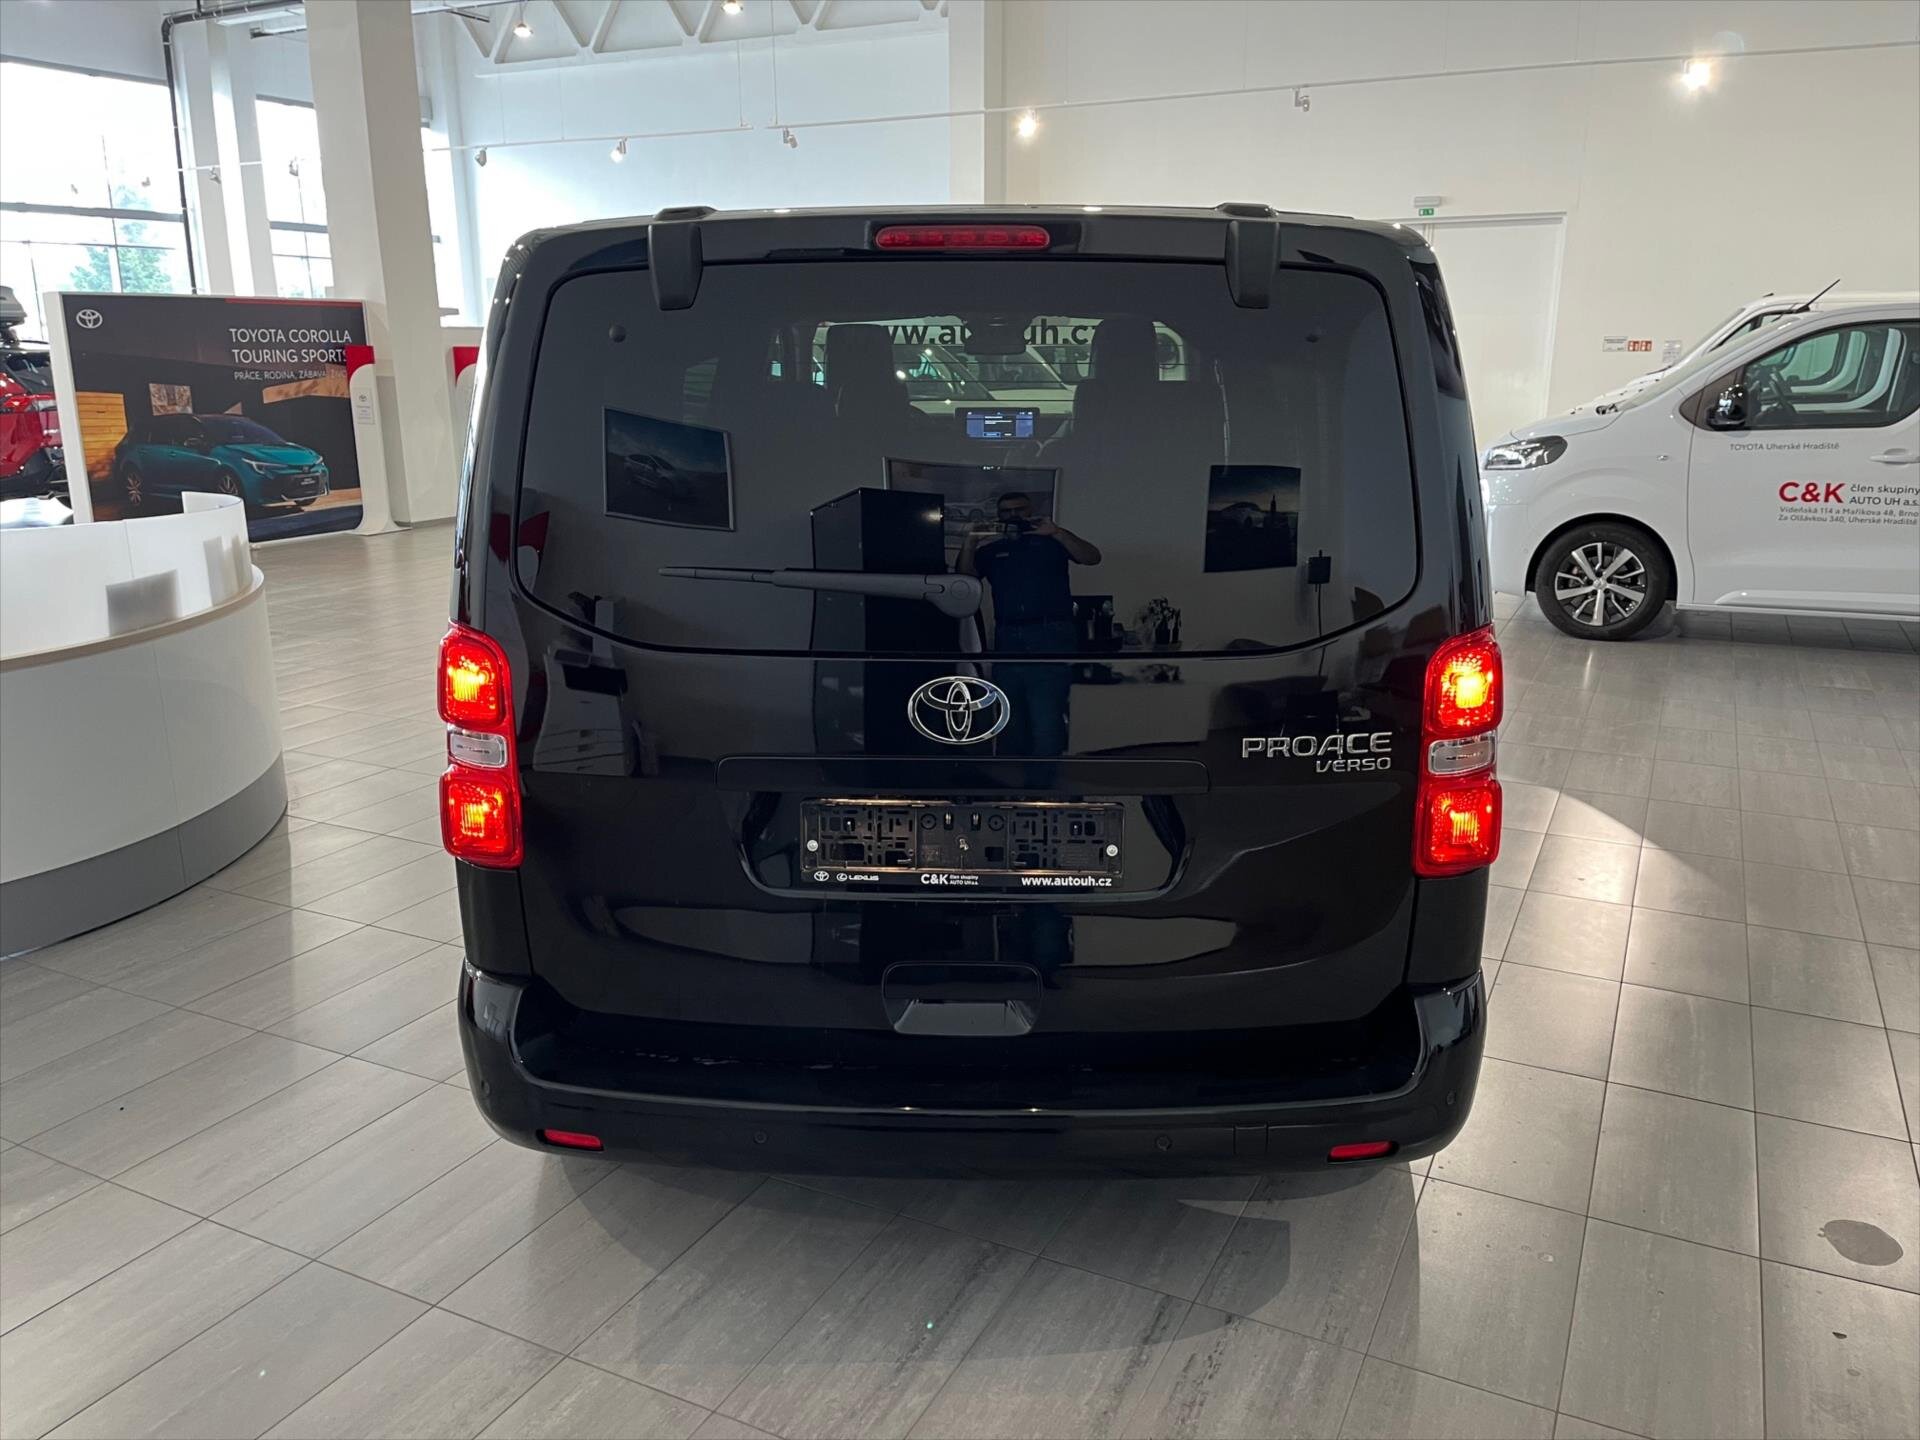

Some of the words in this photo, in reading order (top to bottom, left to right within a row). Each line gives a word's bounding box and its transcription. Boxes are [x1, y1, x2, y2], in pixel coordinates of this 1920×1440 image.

[229, 328, 286, 343] TOYOTA
[288, 329, 352, 343] COROLLA
[232, 349, 298, 363] TOURING
[264, 371, 297, 380] RODINA,
[1730, 443, 1765, 451] TOYOTA
[1766, 442, 1801, 450] Uherské
[1802, 442, 1840, 450] Hradiště
[1778, 481, 1846, 504] C&K
[1850, 483, 1874, 493] člen
[1877, 484, 1920, 496] skupiny
[1849, 496, 1882, 506] AUTO
[1884, 496, 1900, 506] UH
[1778, 513, 1788, 521] Za
[1848, 517, 1880, 525] Uherské
[1883, 518, 1918, 526] Hradiště
[1883, 509, 1896, 518] 48,
[1898, 510, 1919, 518] Brno
[1242, 731, 1393, 758] PROACE
[1315, 757, 1393, 773] VERSO
[920, 873, 949, 885] C&K
[1021, 876, 1112, 887] www.autouh.cz
